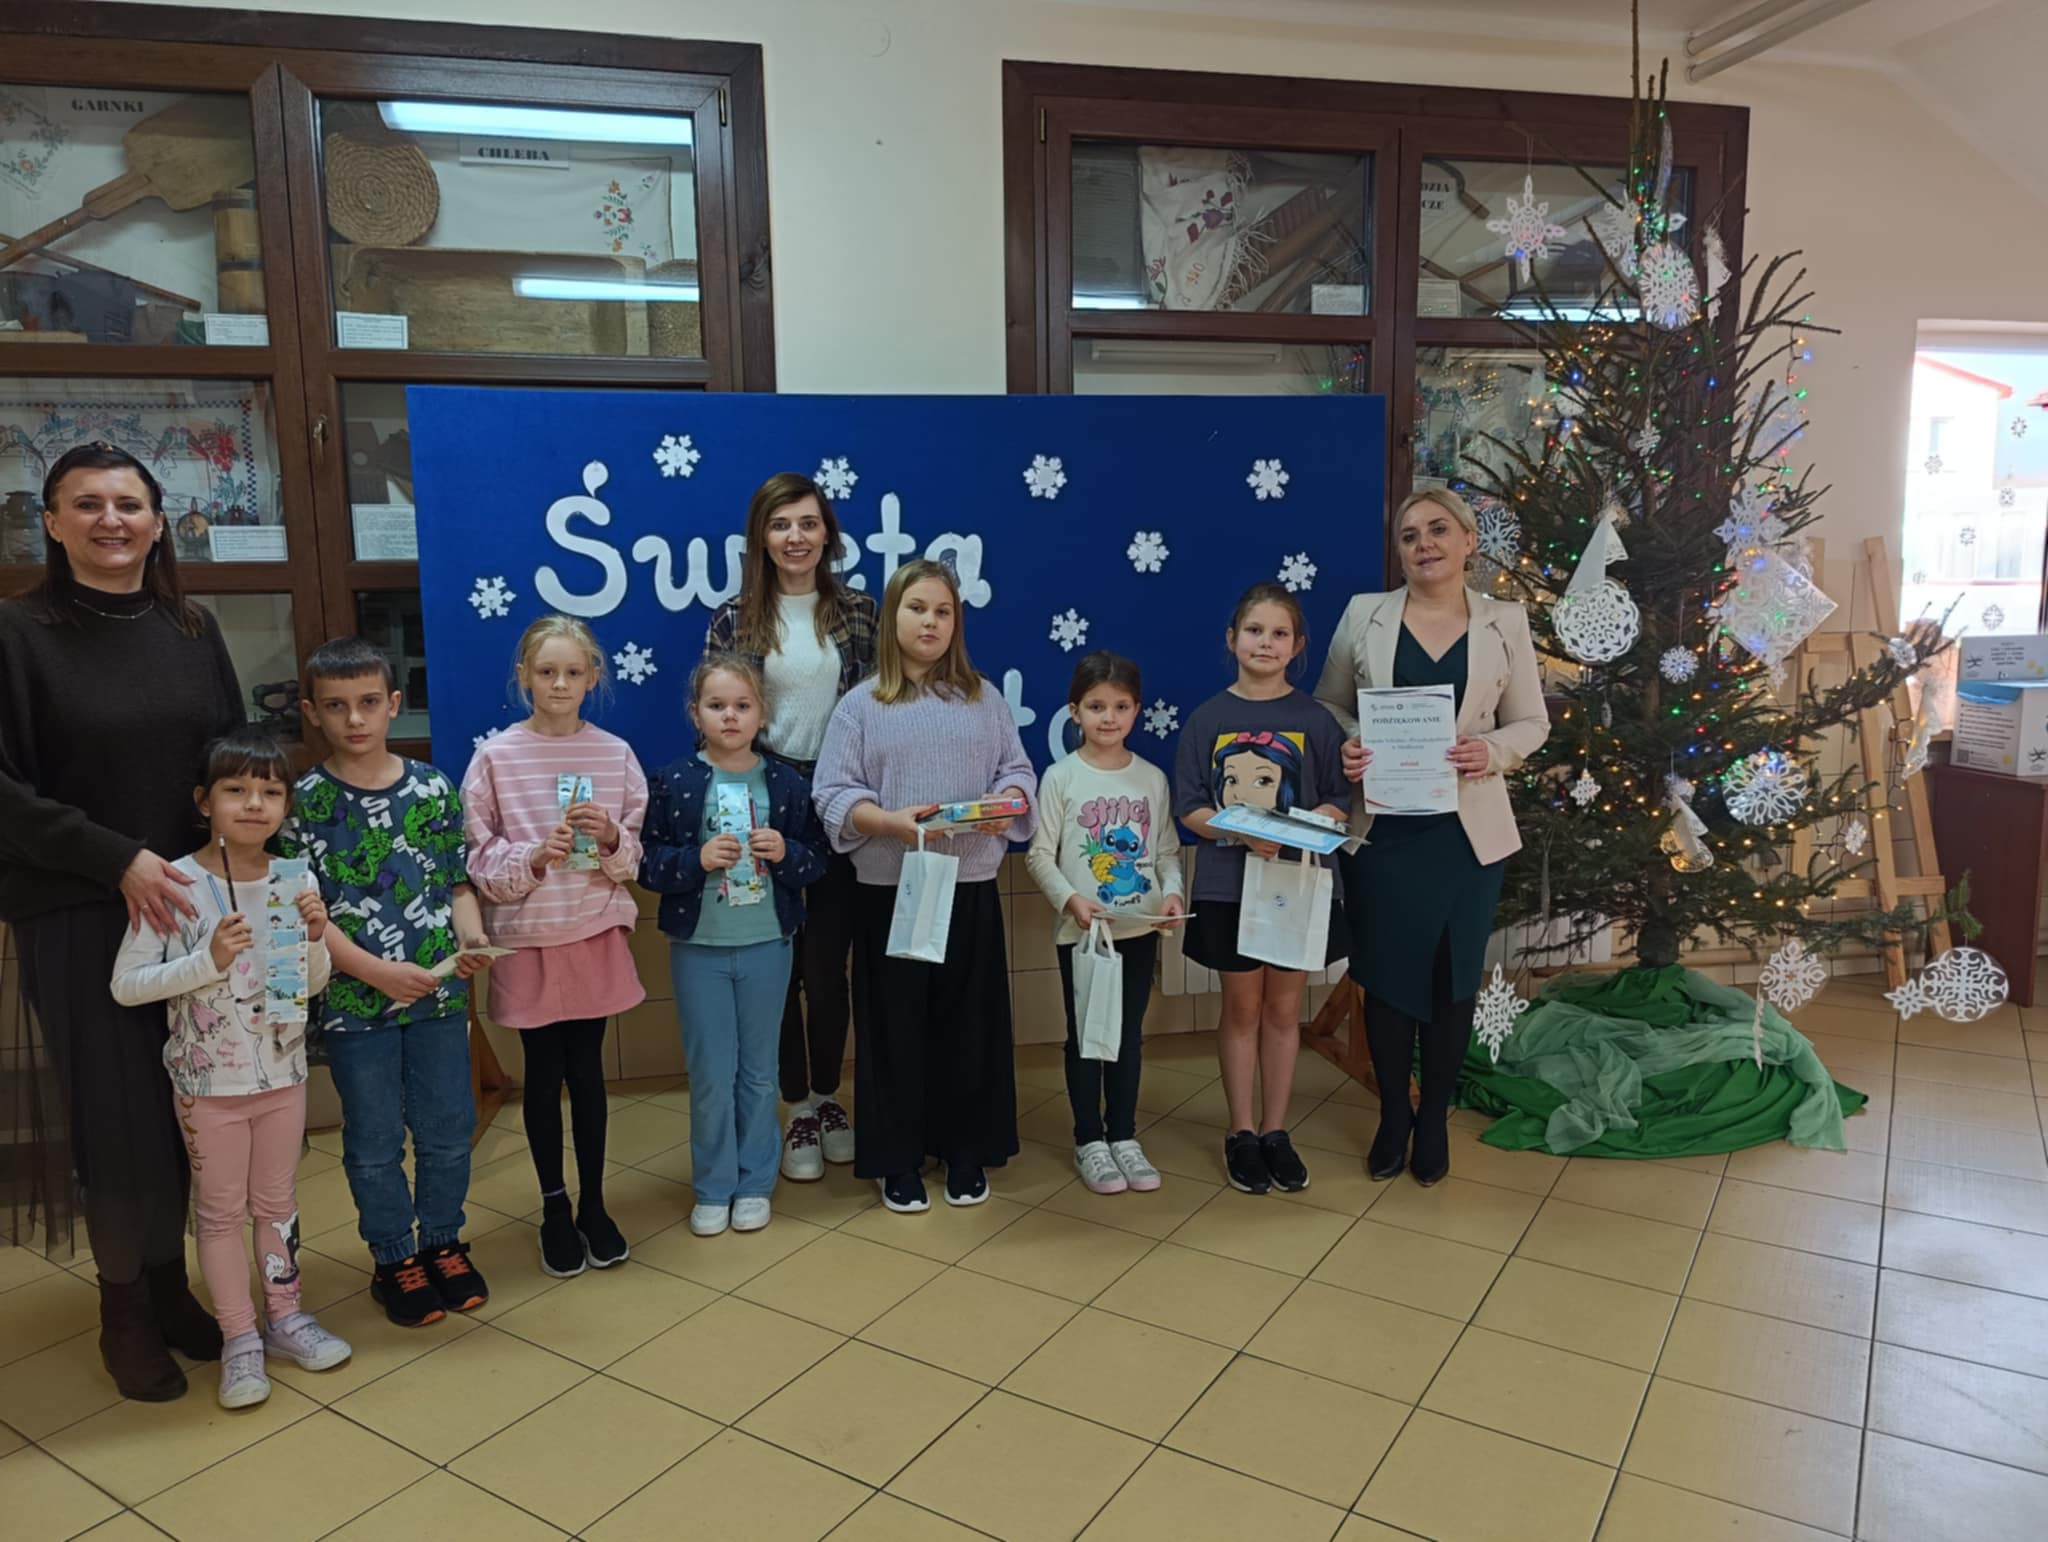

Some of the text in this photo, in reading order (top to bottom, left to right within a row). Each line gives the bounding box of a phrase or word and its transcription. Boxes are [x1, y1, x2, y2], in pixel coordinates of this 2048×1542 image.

[71, 99, 144, 112] GARNKI
[478, 147, 550, 161] CHLEBA
[535, 460, 991, 617] Śwta
